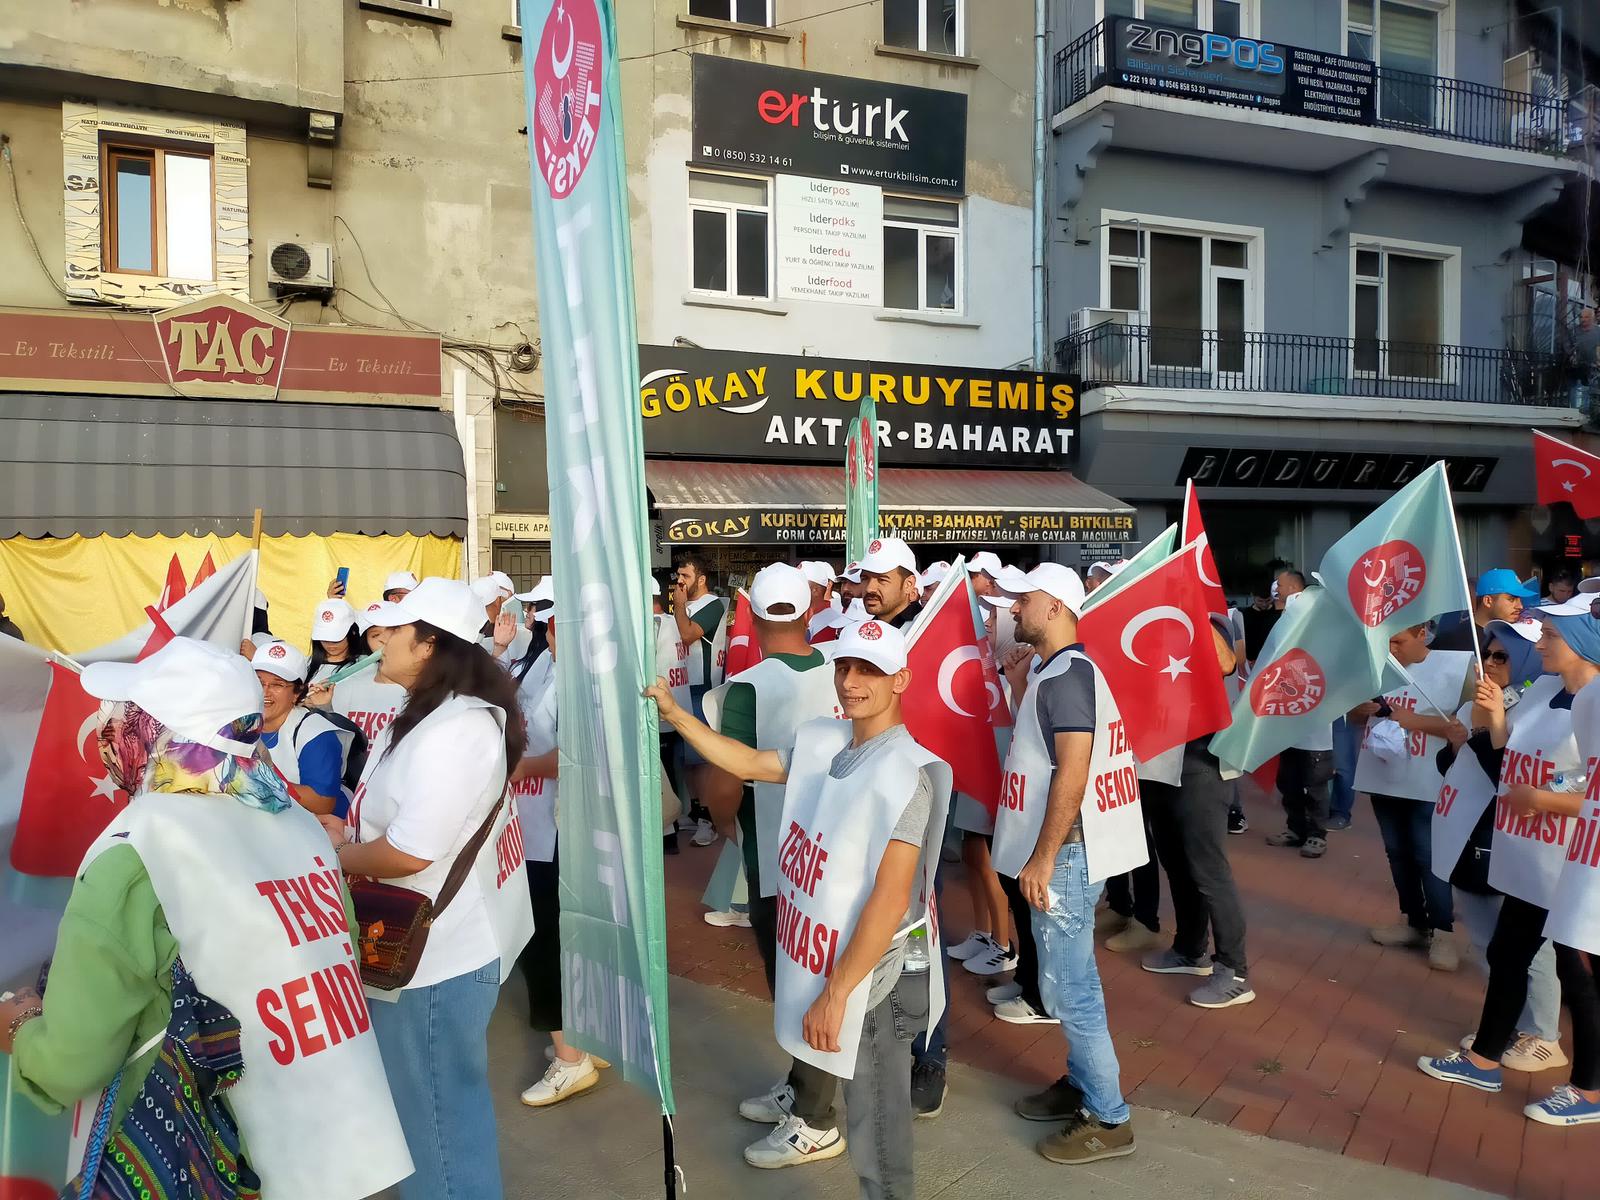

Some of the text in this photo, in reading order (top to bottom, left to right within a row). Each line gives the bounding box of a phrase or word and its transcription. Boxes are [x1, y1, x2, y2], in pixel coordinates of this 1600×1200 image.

[1293, 62, 1314, 74] MARKET
[1356, 87, 1368, 96] POS
[757, 87, 910, 142] ertürk
[837, 133, 844, 142] &
[844, 135, 875, 146] güvenlik
[875, 139, 910, 151] sistemleri
[714, 147, 793, 168] 0 (850) 532 14 61
[851, 165, 959, 187] www.erturkbilisim.com.tr
[15, 340, 115, 362] Ev Tekstili
[168, 314, 275, 377] TAC
[328, 356, 413, 377] Ev Tekstili
[641, 366, 1075, 419] GÖKAY KURUYEMİŞ
[1191, 454, 1488, 487] BODURLR
[669, 515, 751, 541] GÖKAY
[776, 529, 805, 541] FORM
[1028, 532, 1039, 541] ve
[1082, 530, 1130, 542] MACUNLAR
